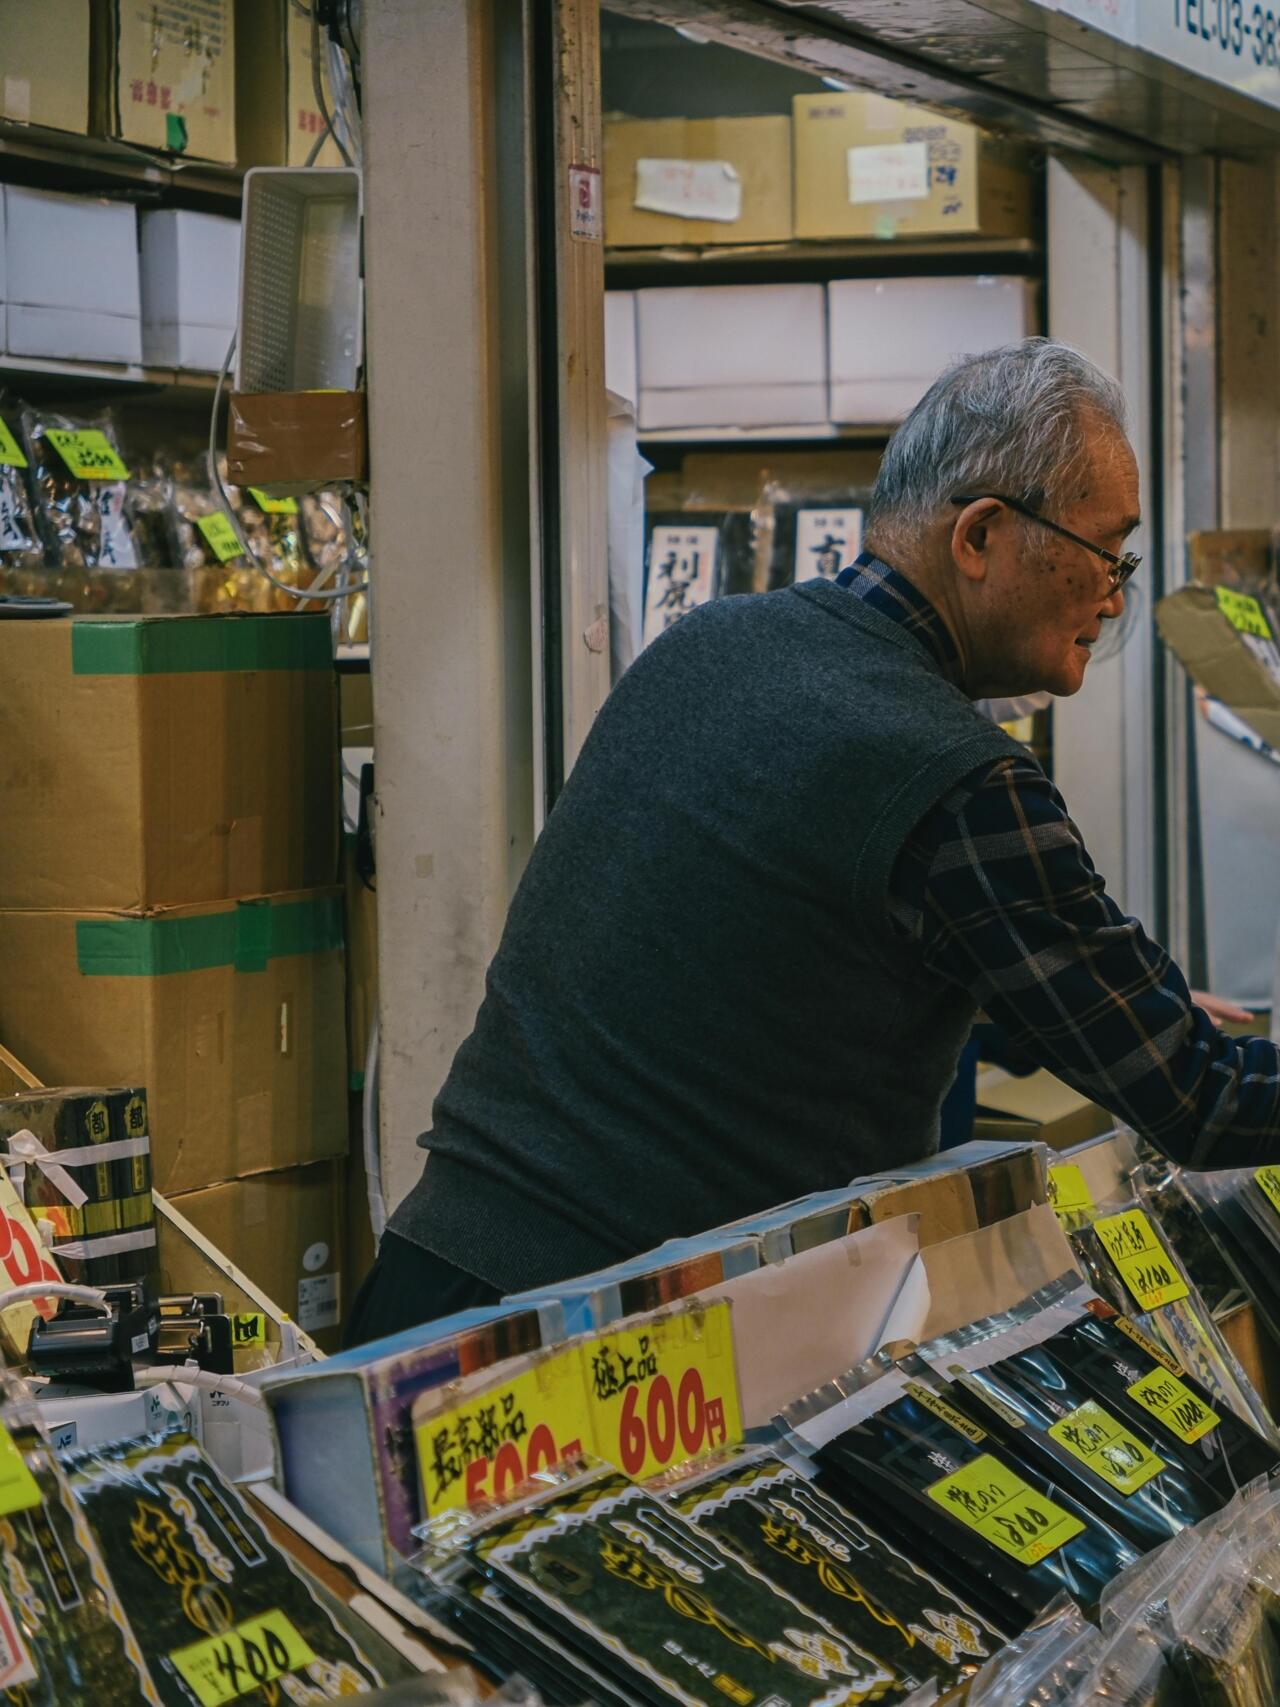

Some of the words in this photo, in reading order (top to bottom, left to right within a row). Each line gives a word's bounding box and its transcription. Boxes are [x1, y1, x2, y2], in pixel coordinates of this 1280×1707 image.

[592, 1335, 658, 1401] 極上品
[619, 1367, 727, 1476] 600円
